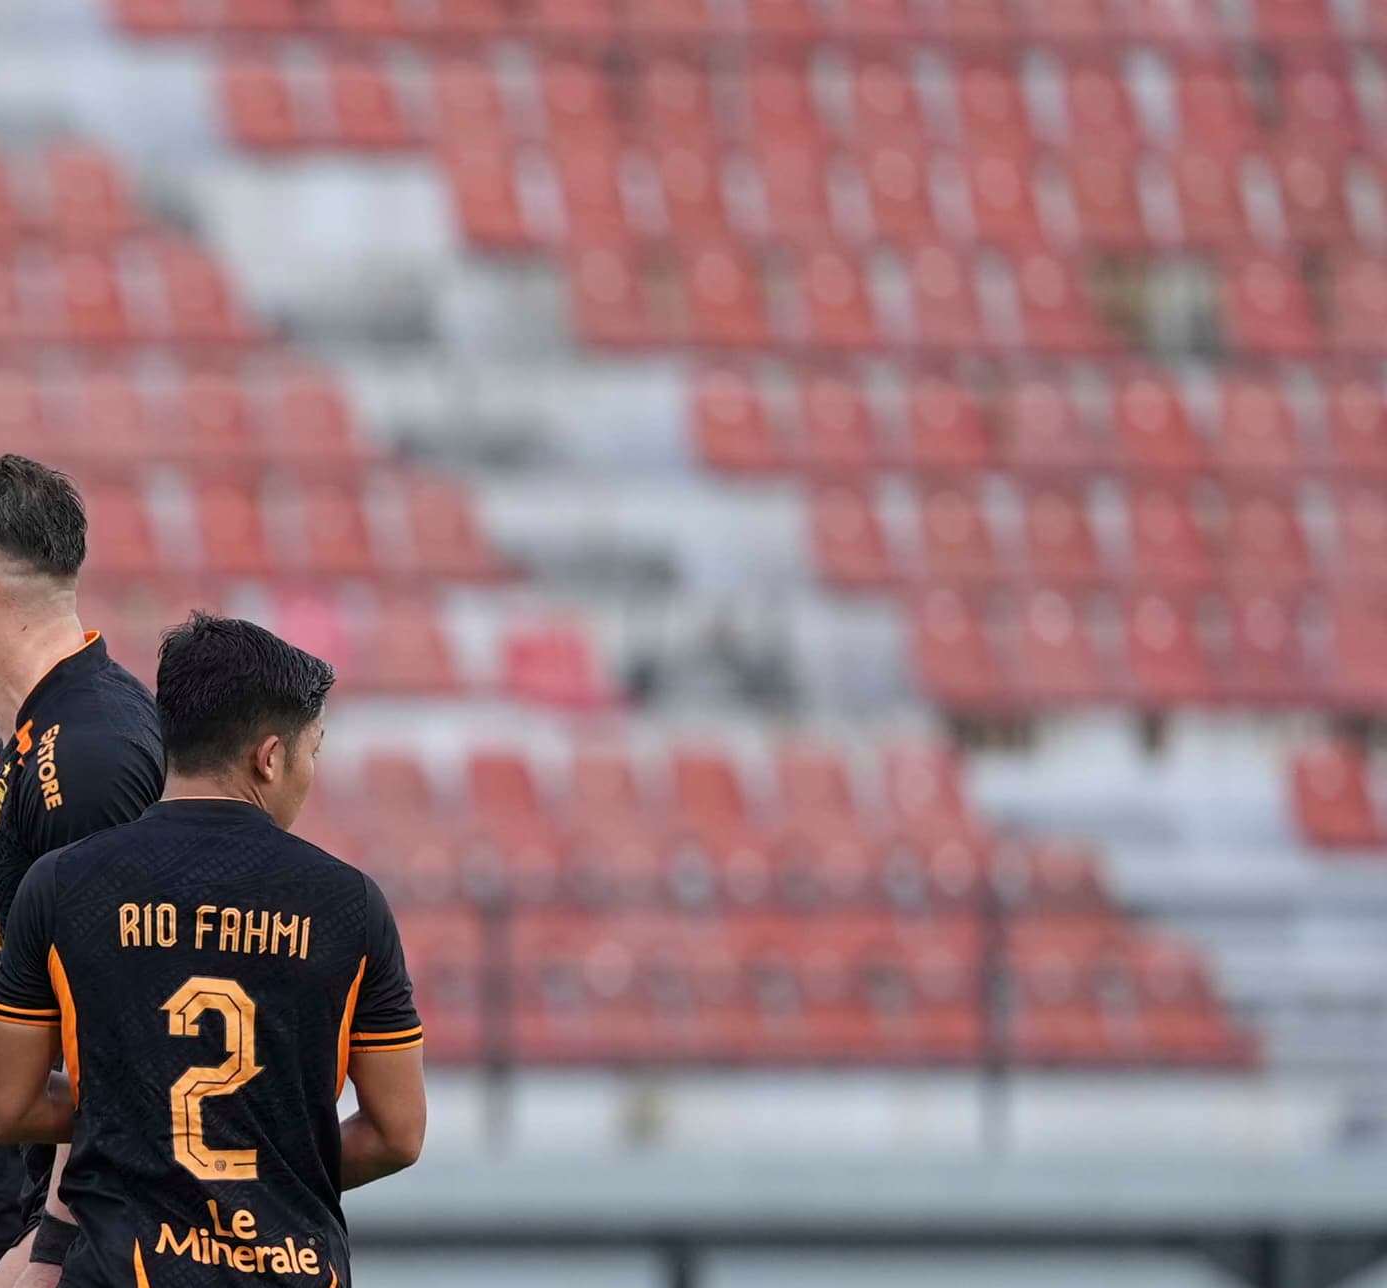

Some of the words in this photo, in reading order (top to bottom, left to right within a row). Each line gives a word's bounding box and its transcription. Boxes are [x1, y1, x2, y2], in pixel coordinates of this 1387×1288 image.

[118, 902, 178, 949] RIO
[194, 904, 312, 960] FAHMI
[160, 975, 266, 1181] 2
[206, 1199, 258, 1240] Le
[155, 1222, 321, 1275] Minerale
